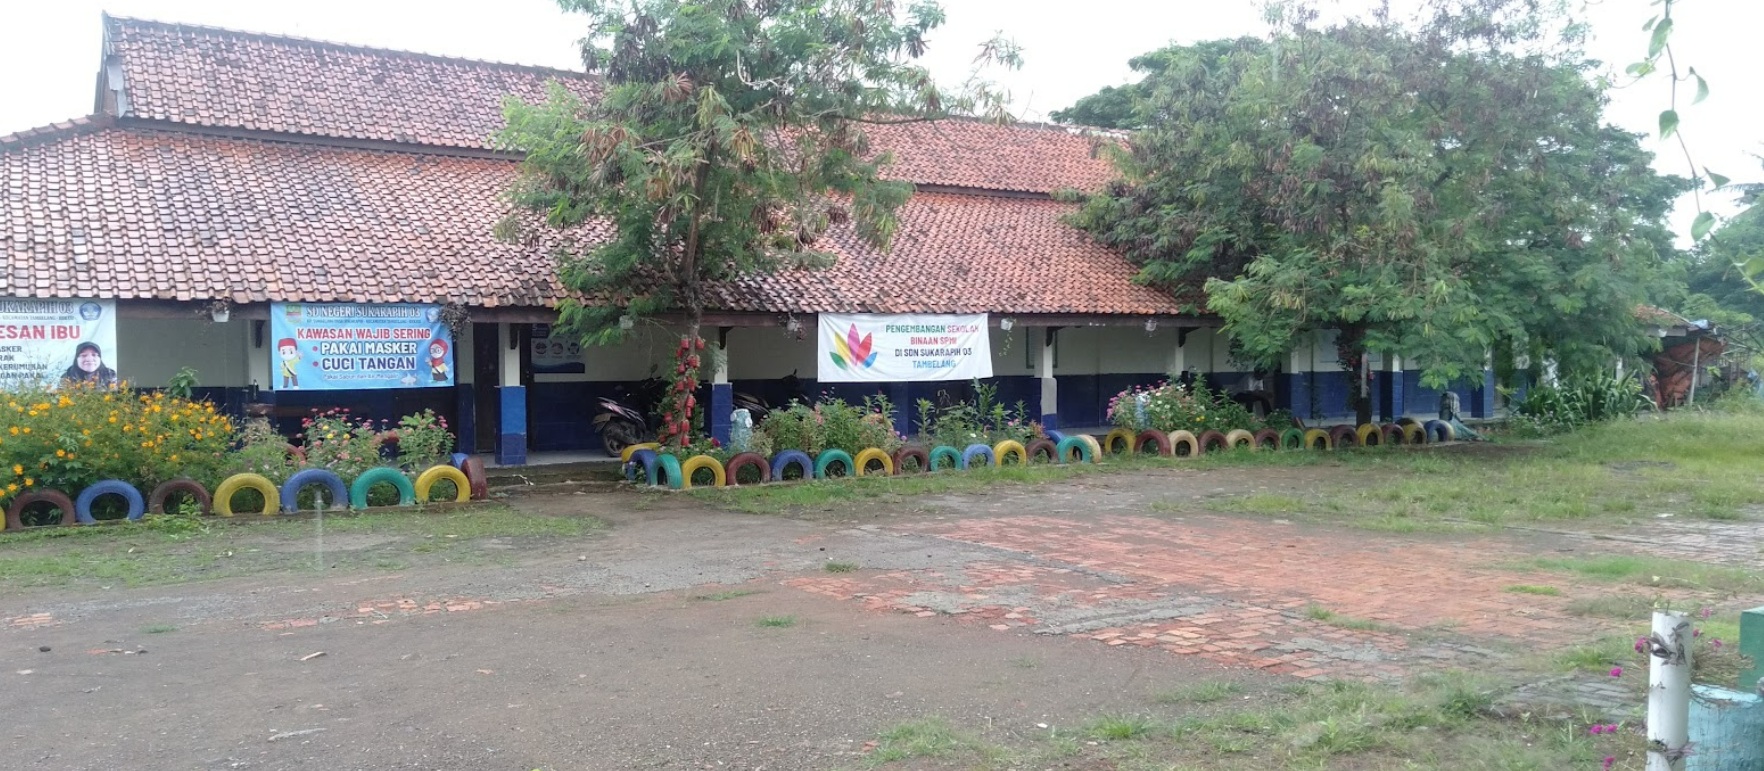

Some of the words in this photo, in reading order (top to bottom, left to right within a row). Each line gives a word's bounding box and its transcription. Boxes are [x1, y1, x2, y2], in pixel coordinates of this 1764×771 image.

[59, 301, 74, 313] 03
[307, 306, 319, 317] SD
[321, 306, 355, 317] NEGERI
[356, 306, 409, 317] SUKARAPIH
[410, 306, 421, 317] 03
[51, 325, 80, 339] IBU
[297, 328, 352, 339] KAWASAN
[356, 328, 390, 339] WAJIB
[393, 328, 431, 339] SERING
[885, 325, 946, 333] PENGEMBANGAN
[947, 325, 979, 333] SEKOLAH
[910, 337, 938, 345] BINAAN
[321, 342, 362, 355] PAKAI
[365, 342, 417, 355] MASKER
[895, 349, 902, 357] DI
[904, 349, 919, 357] SDN
[920, 348, 961, 357] SUKARAPIH
[963, 347, 973, 356] 03
[322, 358, 354, 370] CUCI
[358, 357, 415, 370] TANGAN
[912, 360, 957, 369] TAMBELANG
